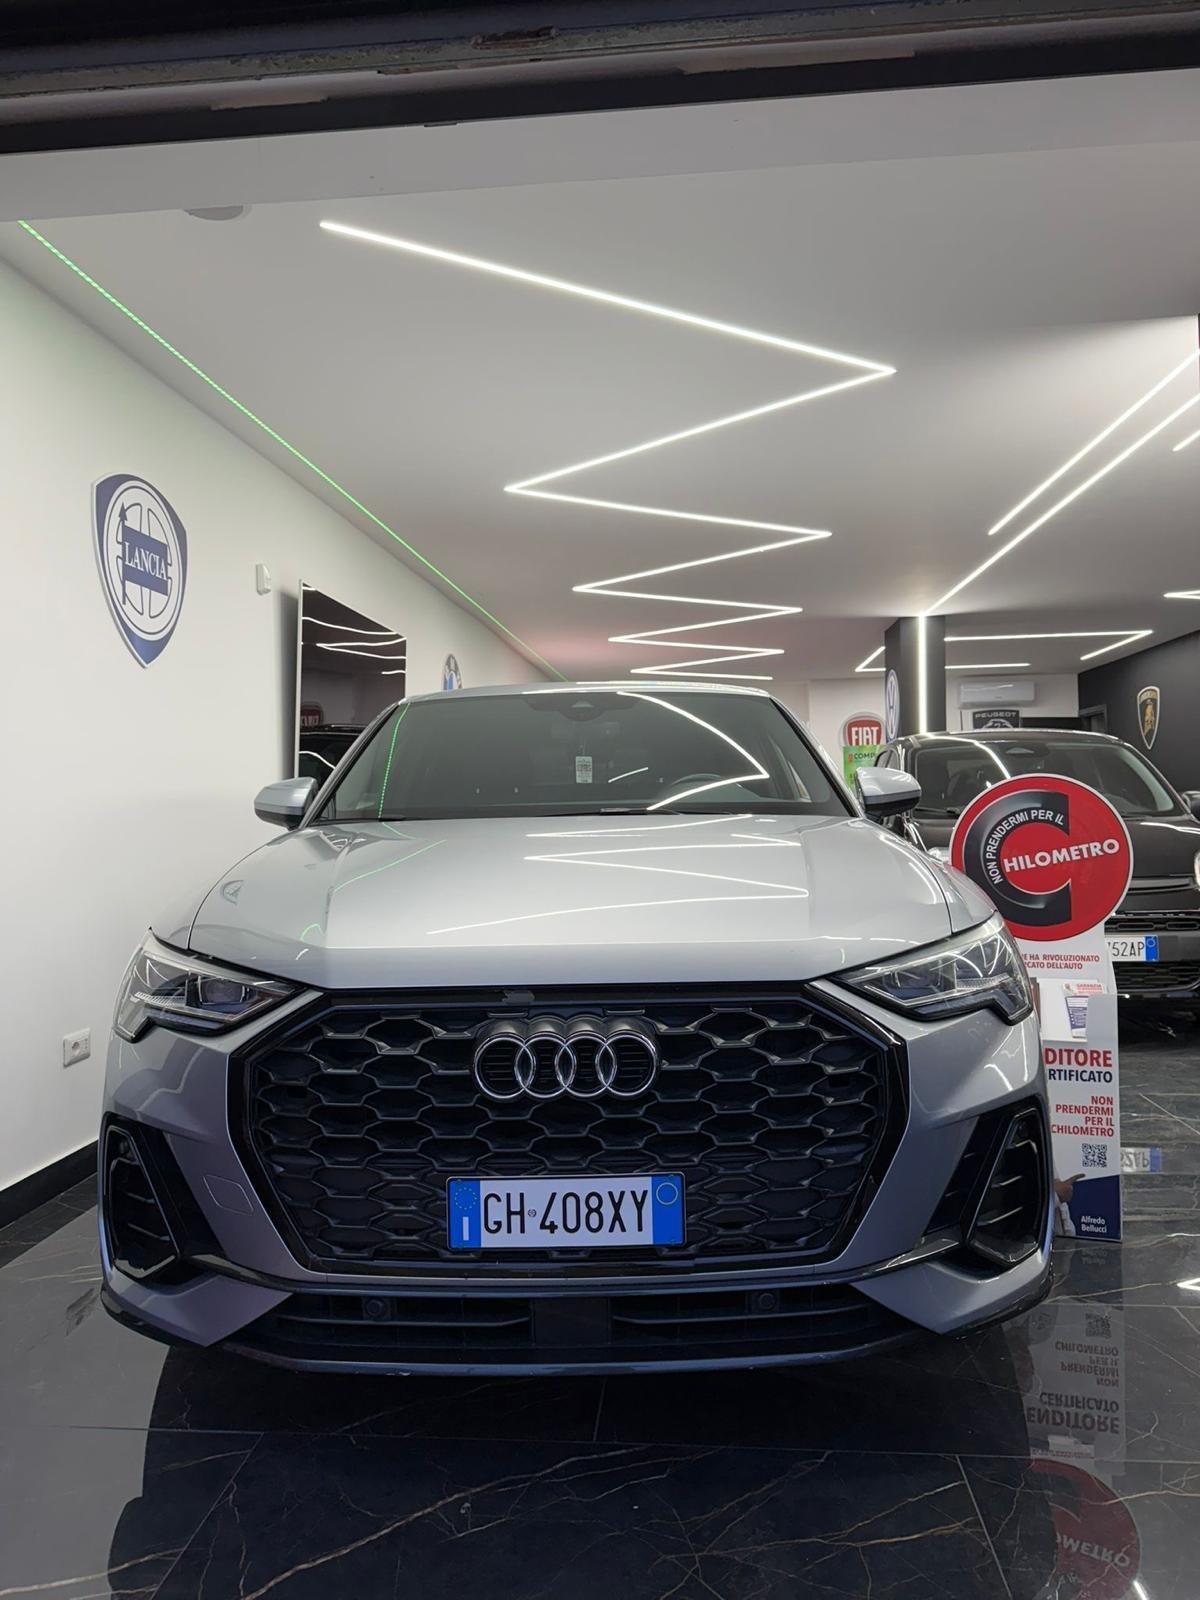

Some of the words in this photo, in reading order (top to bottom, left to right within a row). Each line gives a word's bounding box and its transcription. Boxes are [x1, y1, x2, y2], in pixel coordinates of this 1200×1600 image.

[125, 541, 167, 580] LANCIA
[851, 727, 879, 746] FIAT
[1031, 809, 1053, 820] PER
[1054, 813, 1064, 826] IL
[986, 811, 1029, 859] PRENDERMI
[986, 861, 1003, 884] NON
[1107, 941, 1145, 957] 52AP
[1042, 954, 1100, 962] RIVOLUZIONATO
[1047, 962, 1083, 970] DELL'AUTO
[1044, 1048, 1112, 1067] DITORE
[1048, 1068, 1113, 1083] RTIFICATO
[1091, 1095, 1114, 1106] NON
[1055, 1104, 1114, 1116] PRENDERMI
[1085, 1116, 1104, 1126] PER
[1106, 1117, 1115, 1127] IL
[1051, 1124, 1114, 1137] CHILOMETRO
[1081, 1215, 1106, 1225] Alfredo
[1081, 1224, 1107, 1233] Bellucci
